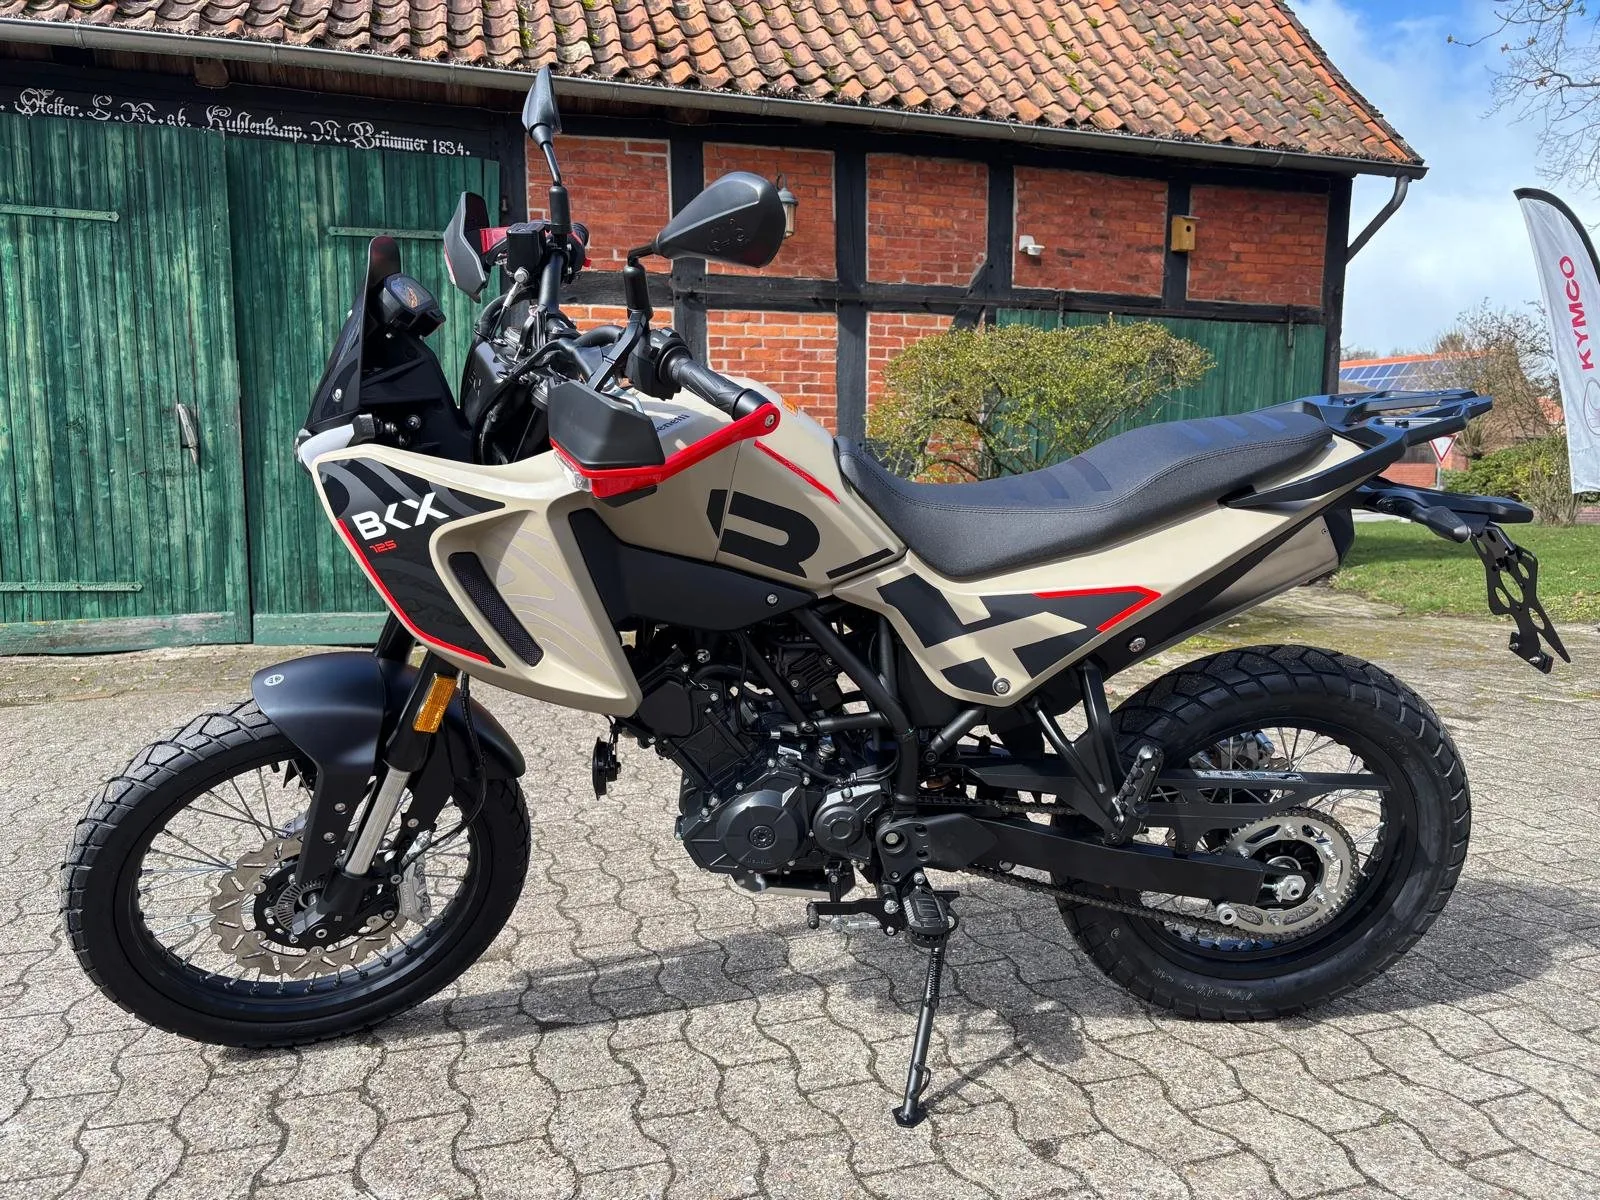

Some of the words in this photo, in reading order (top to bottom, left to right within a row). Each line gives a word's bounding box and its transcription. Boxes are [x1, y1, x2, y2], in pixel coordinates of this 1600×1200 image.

[1559, 255, 1595, 371] KYMCO
[656, 413, 691, 432] enelli
[351, 491, 450, 541] BKX
[369, 539, 398, 553] 125
